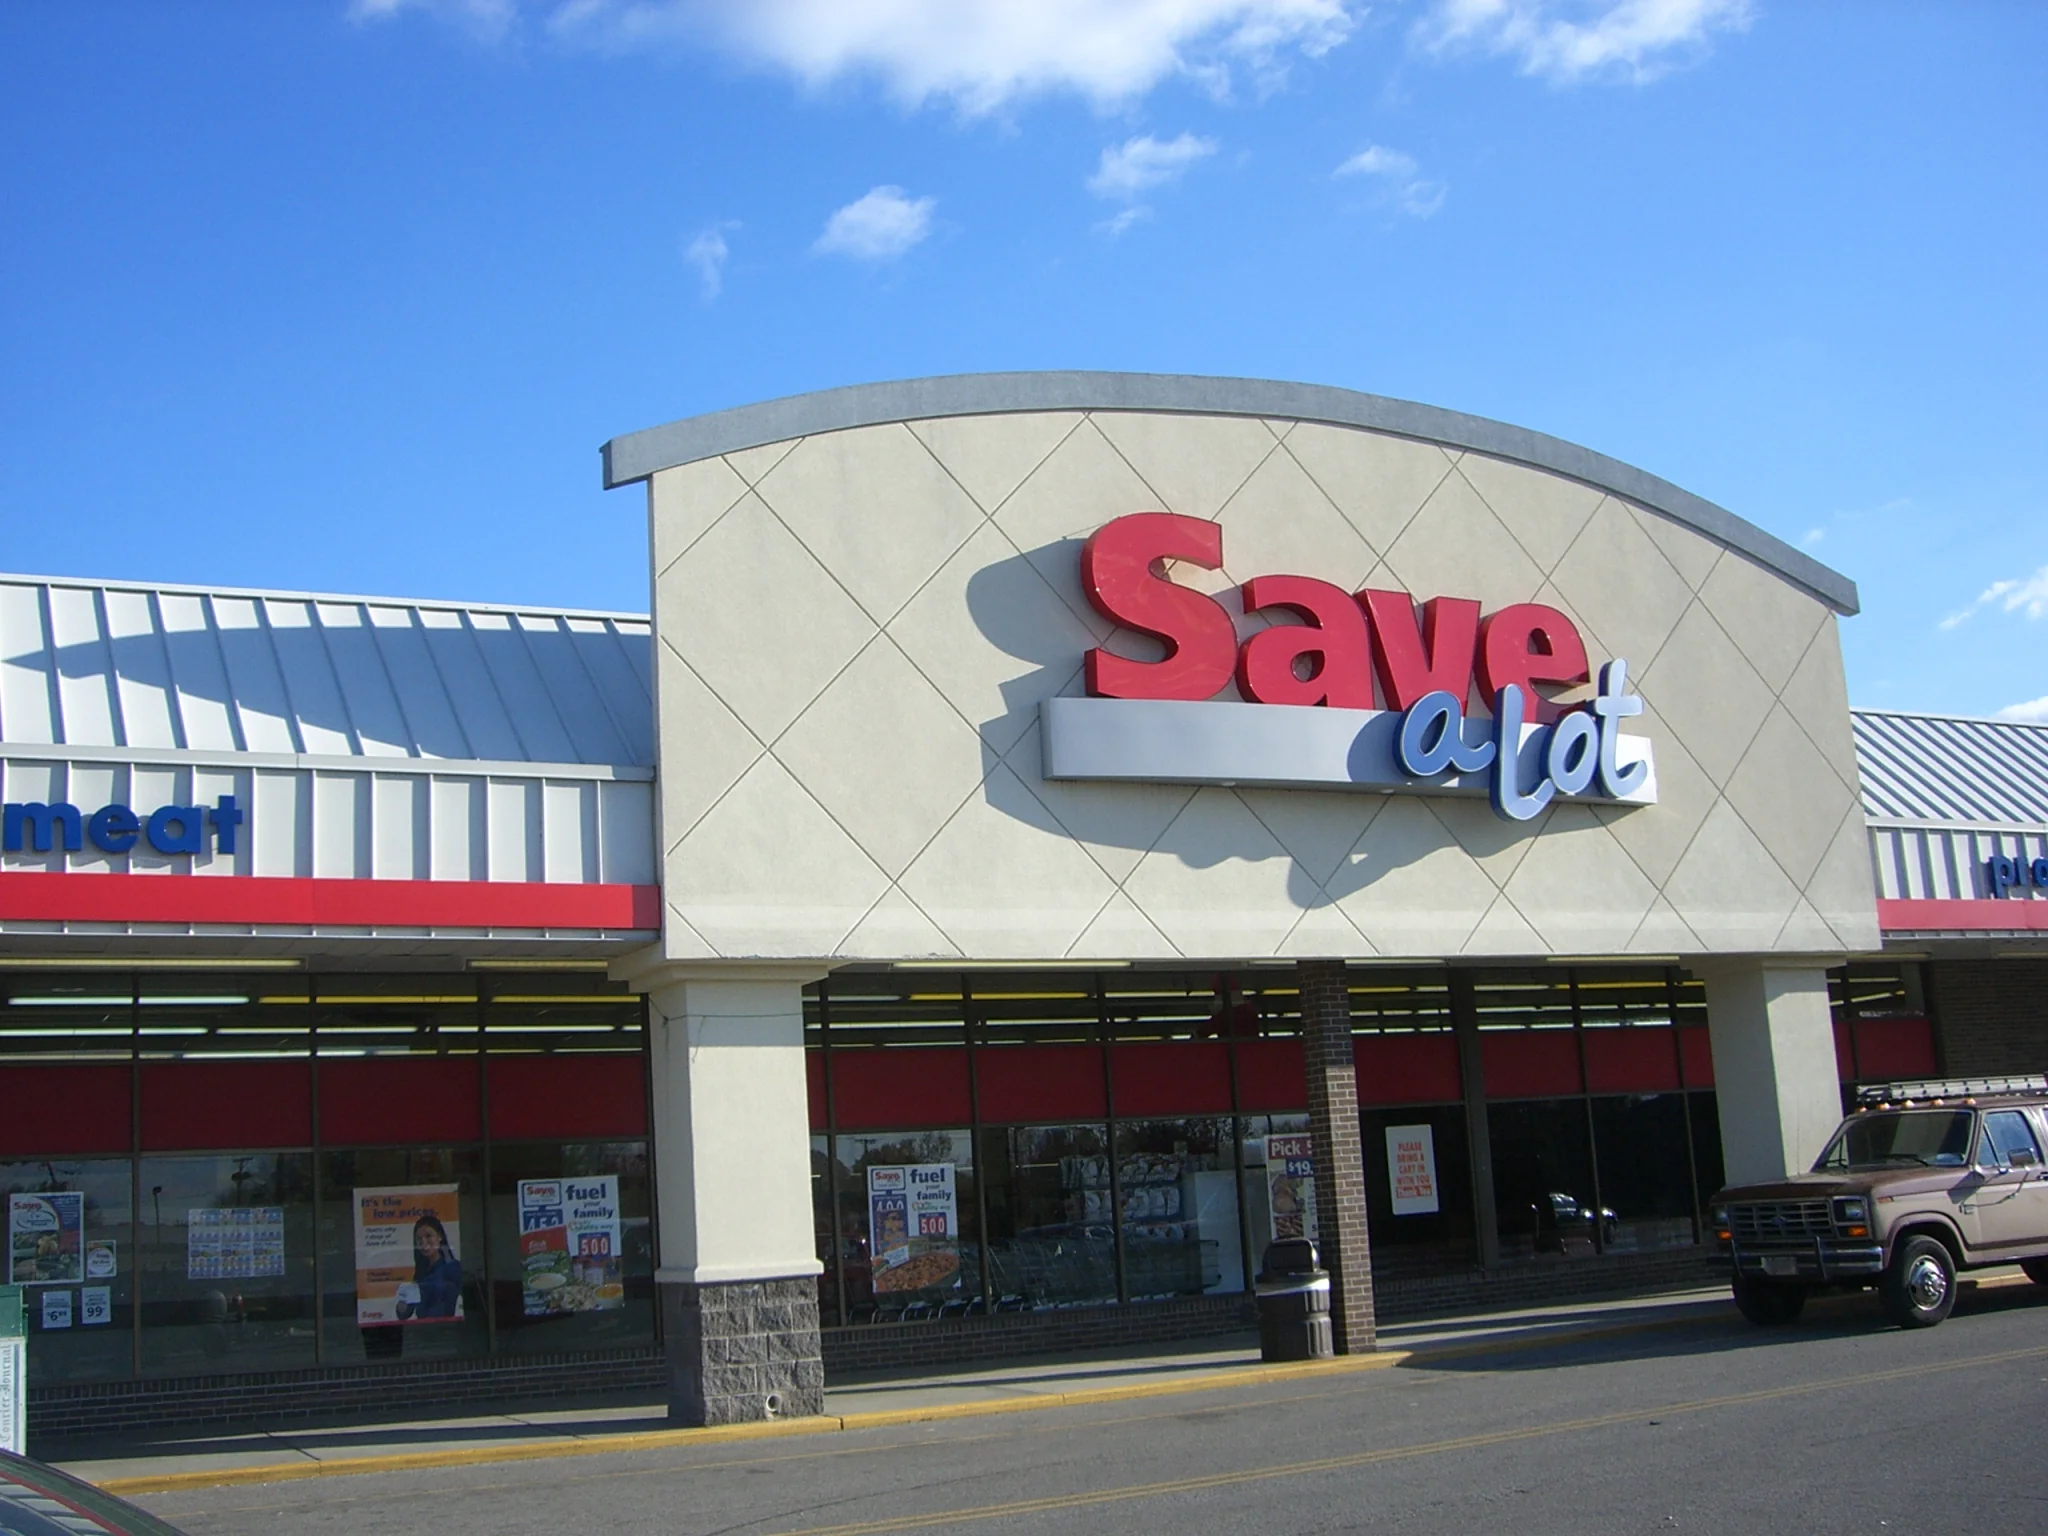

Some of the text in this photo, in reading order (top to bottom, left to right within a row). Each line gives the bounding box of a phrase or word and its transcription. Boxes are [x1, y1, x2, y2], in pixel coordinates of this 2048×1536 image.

[1080, 512, 1591, 723] Save
[3, 795, 243, 855] meat
[1271, 1139, 1302, 1157] Pick
[1398, 1141, 1422, 1151] PLEASE
[1397, 1153, 1418, 1163] BRING
[1398, 1164, 1415, 1174] CART
[910, 1168, 945, 1183] fuel
[1396, 1176, 1415, 1185] WITH
[565, 1183, 606, 1200] fuel
[916, 1190, 952, 1201] family
[361, 1196, 402, 1207] It's the
[372, 1208, 395, 1218] low
[573, 1207, 615, 1218] family
